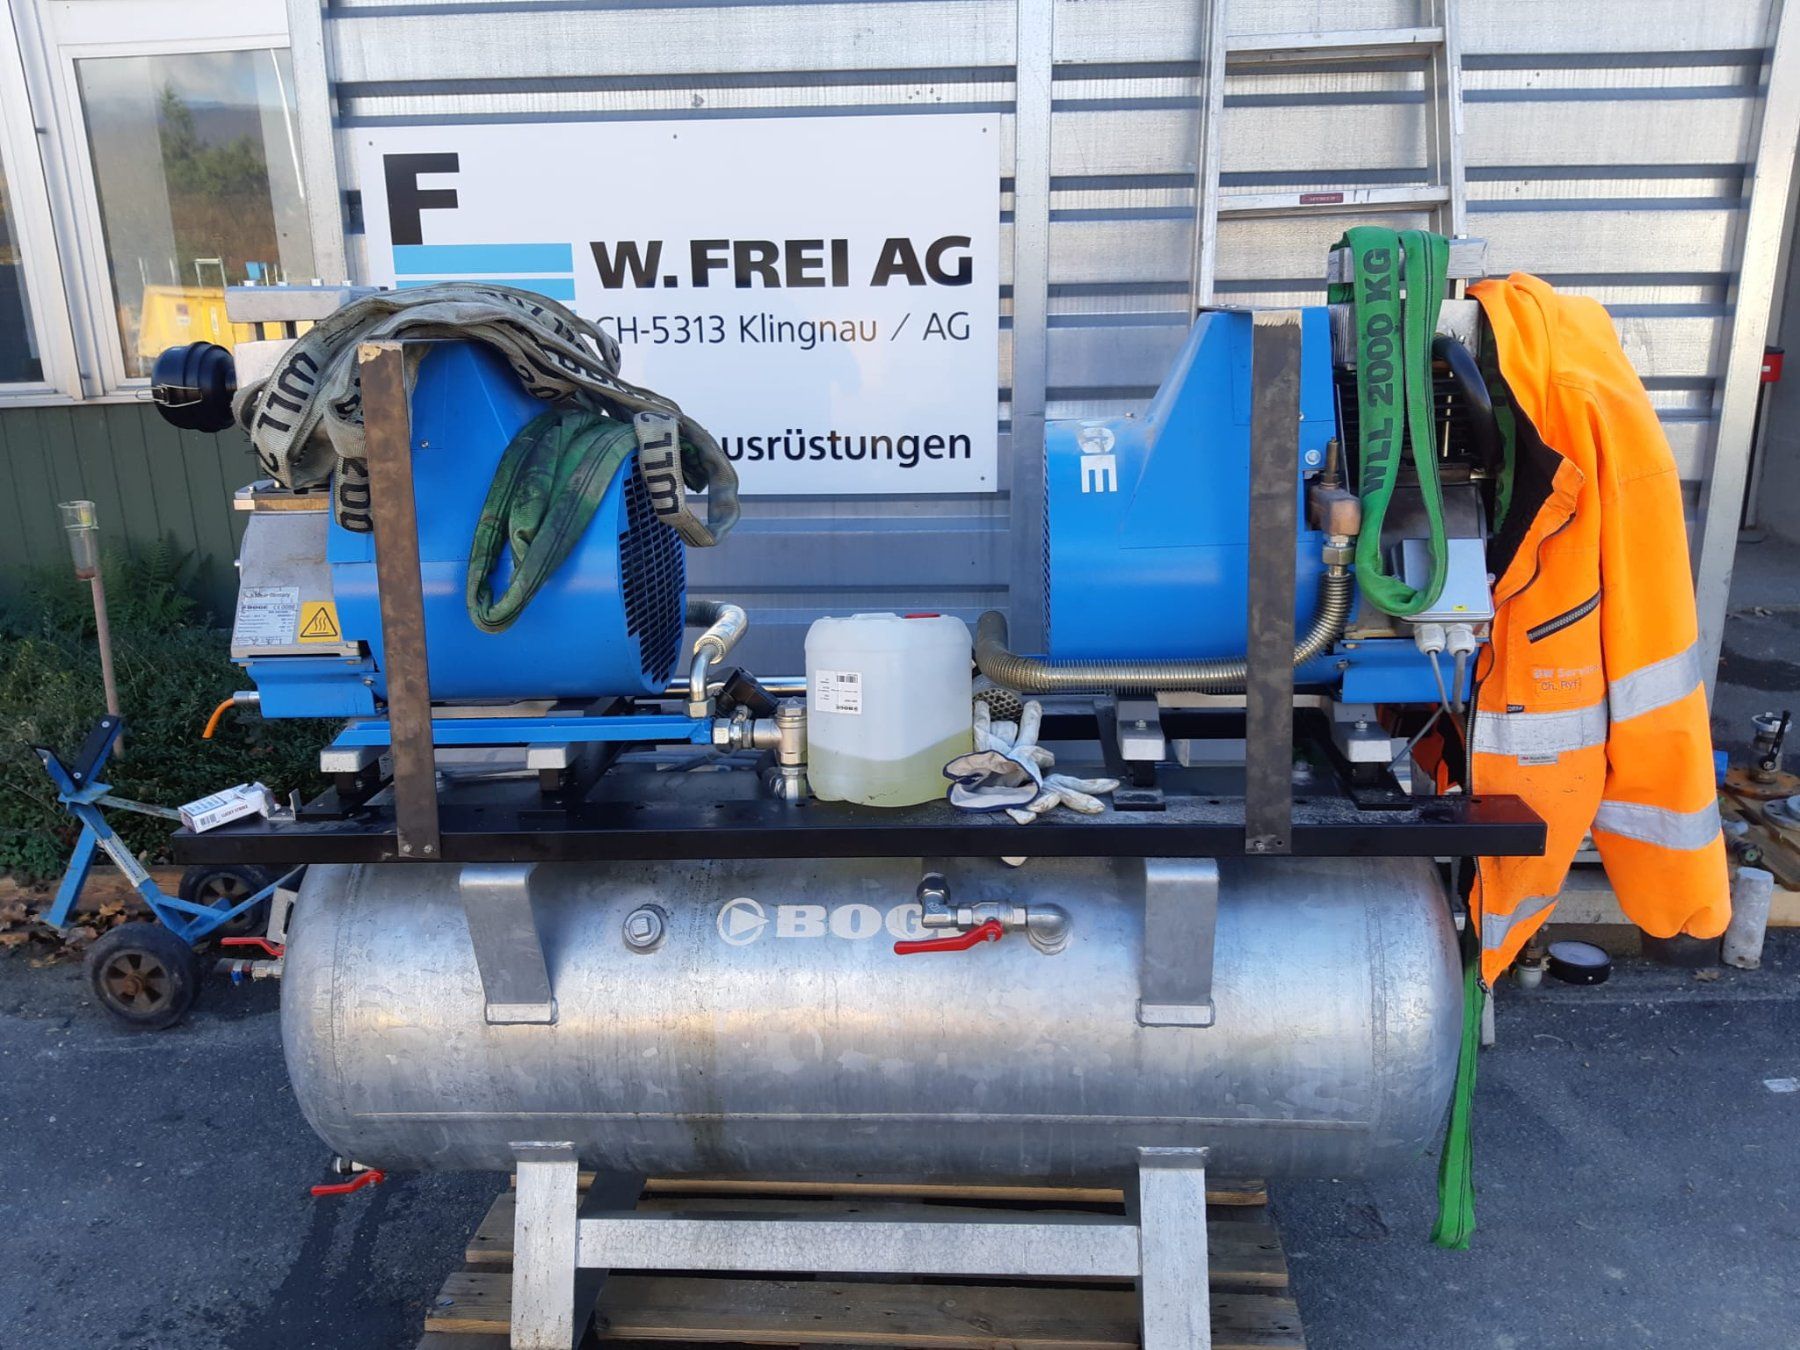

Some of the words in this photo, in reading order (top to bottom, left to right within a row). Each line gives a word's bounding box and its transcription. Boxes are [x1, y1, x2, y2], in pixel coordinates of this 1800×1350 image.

[870, 235, 973, 287] AG
[1363, 248, 1394, 304] KG
[740, 313, 877, 350] Klingnau
[923, 311, 971, 342] AG
[1367, 313, 1394, 407] 2000
[720, 429, 972, 468] usrüstungen
[1364, 418, 1394, 497] WLL
[775, 903, 966, 940] BOG
